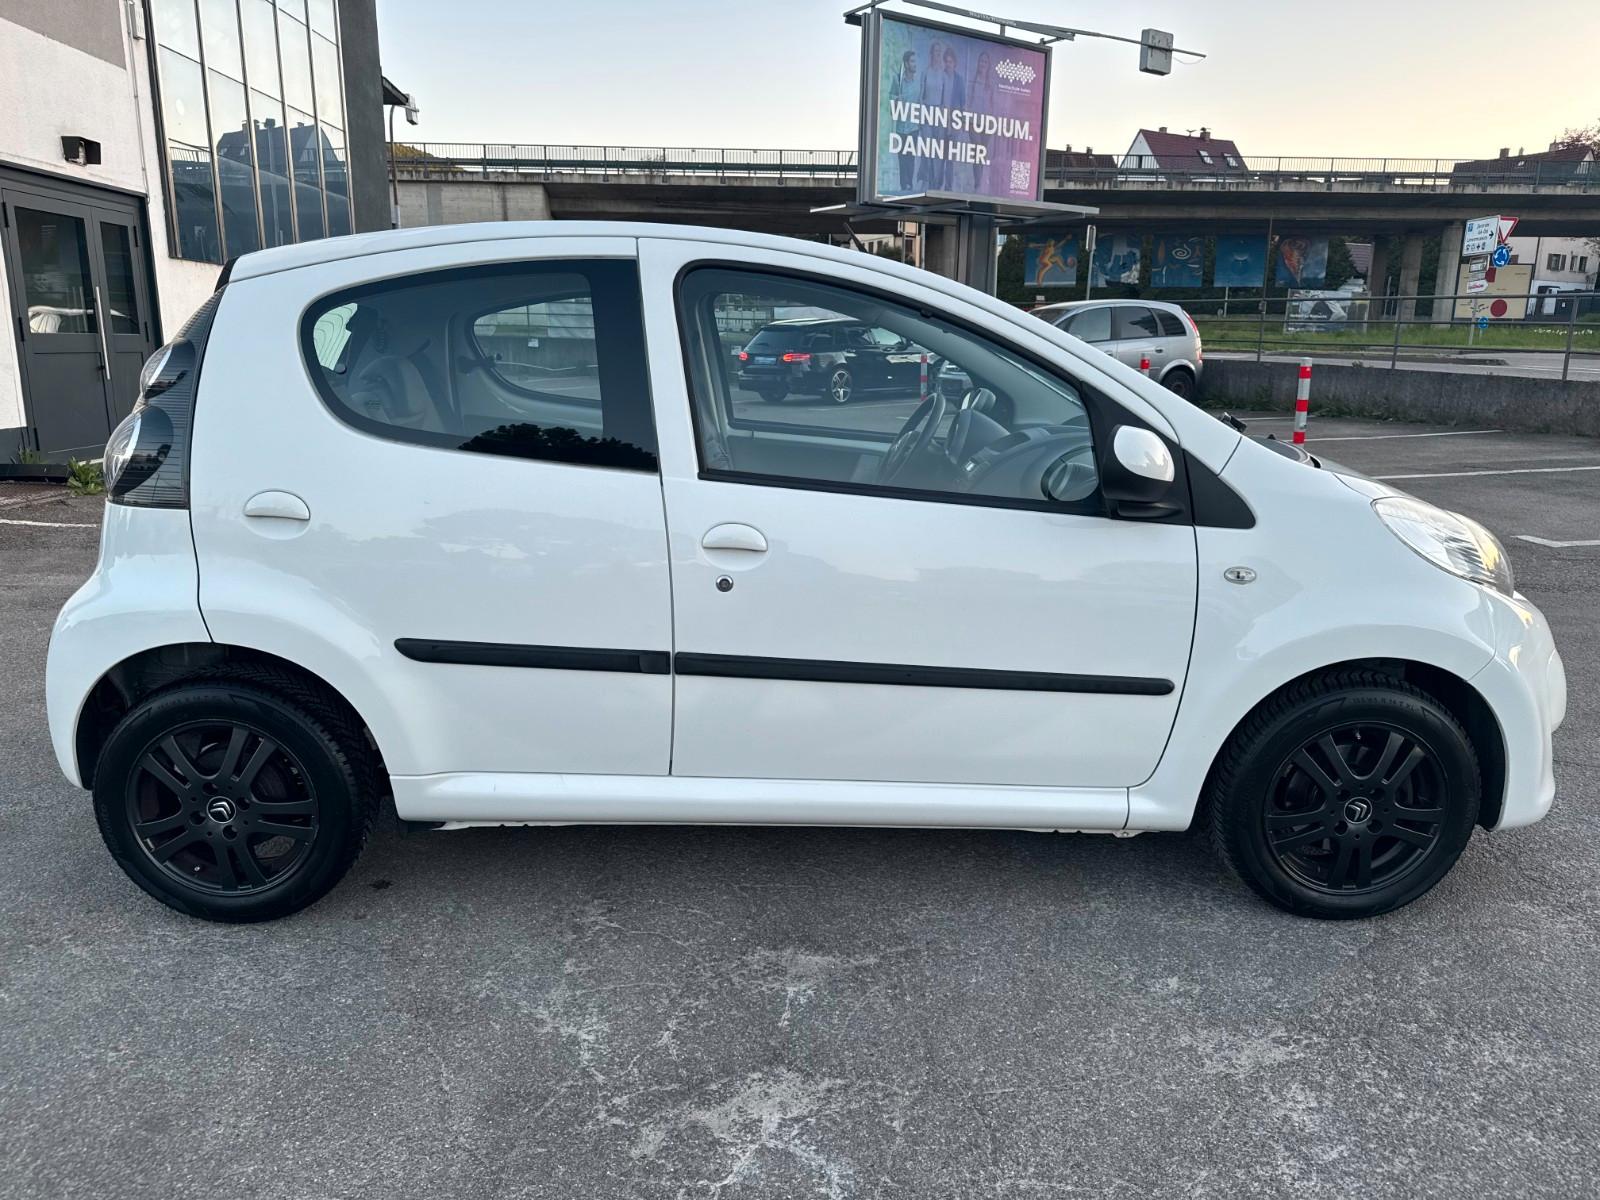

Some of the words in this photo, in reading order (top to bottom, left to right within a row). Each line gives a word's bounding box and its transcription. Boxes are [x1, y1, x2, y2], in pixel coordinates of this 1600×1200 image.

[890, 99, 948, 128] WENN
[951, 109, 1033, 141] STUDIUM.
[889, 132, 945, 160] DANN
[948, 140, 990, 165] HIER.
